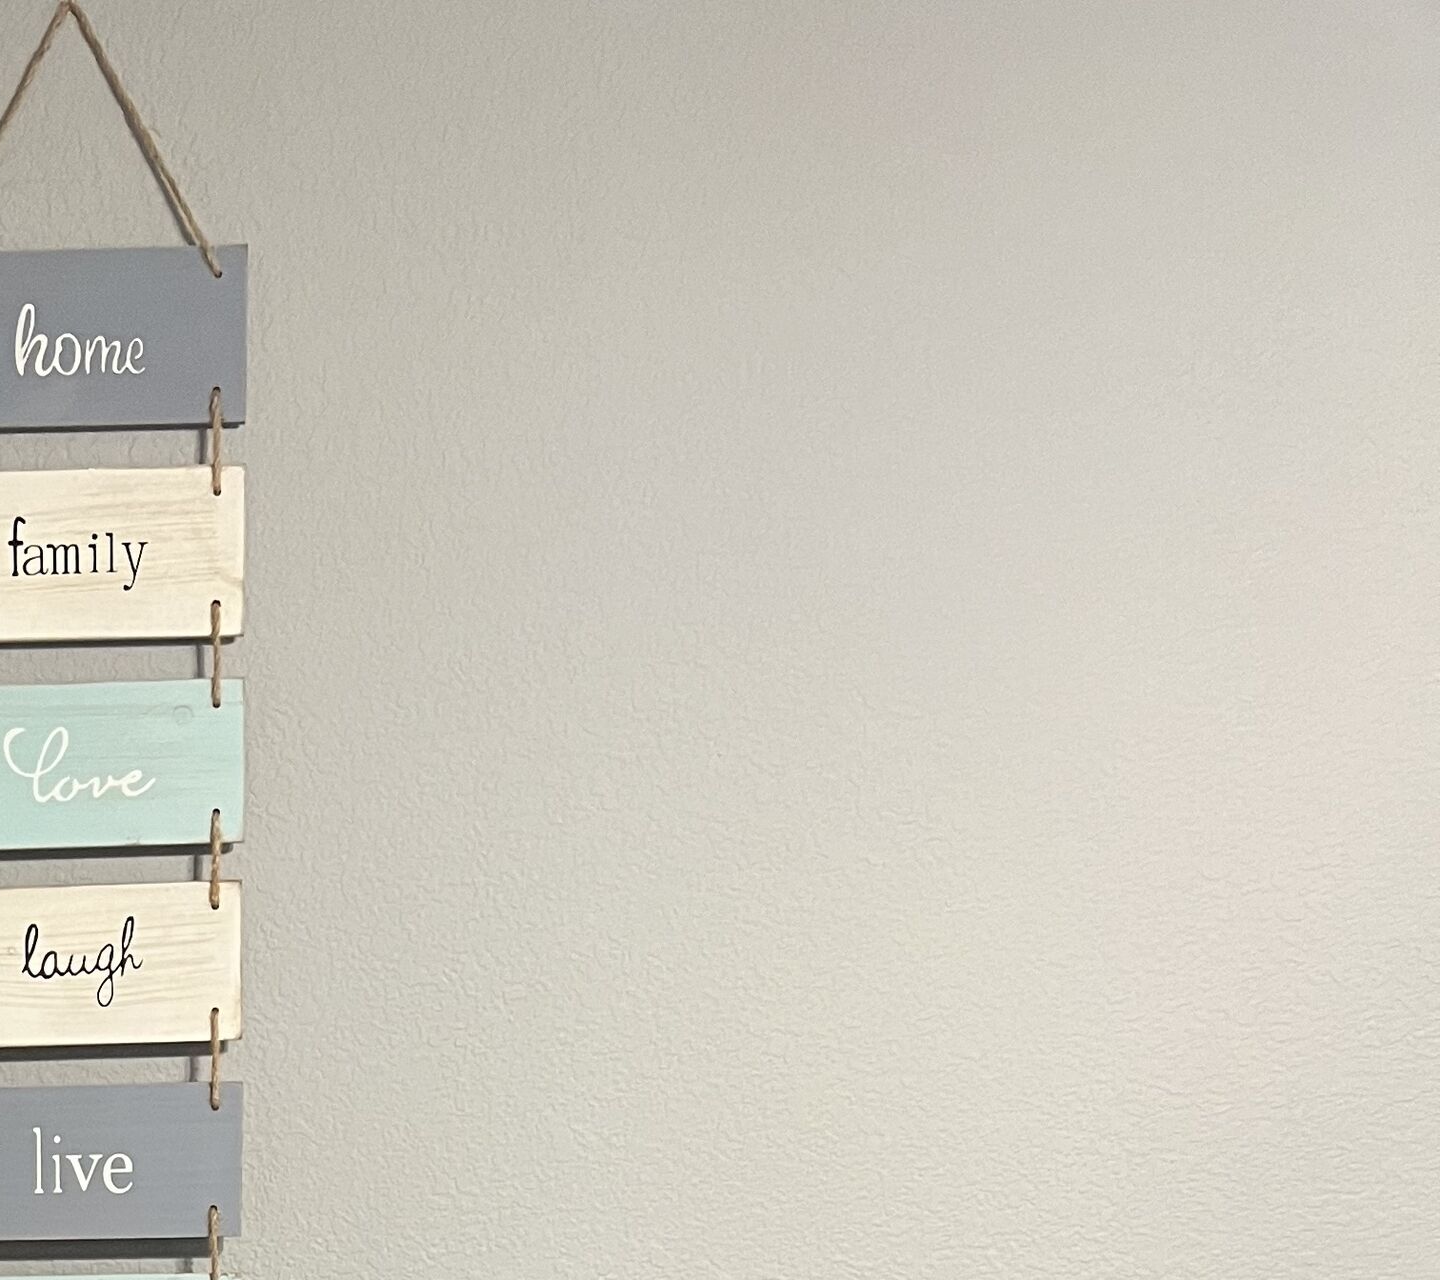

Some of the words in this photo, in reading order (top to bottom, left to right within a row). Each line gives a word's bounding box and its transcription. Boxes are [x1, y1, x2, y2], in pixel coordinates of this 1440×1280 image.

[15, 303, 146, 376] home
[8, 516, 148, 591] family
[22, 916, 143, 1008] laugh
[32, 1127, 134, 1195] live
